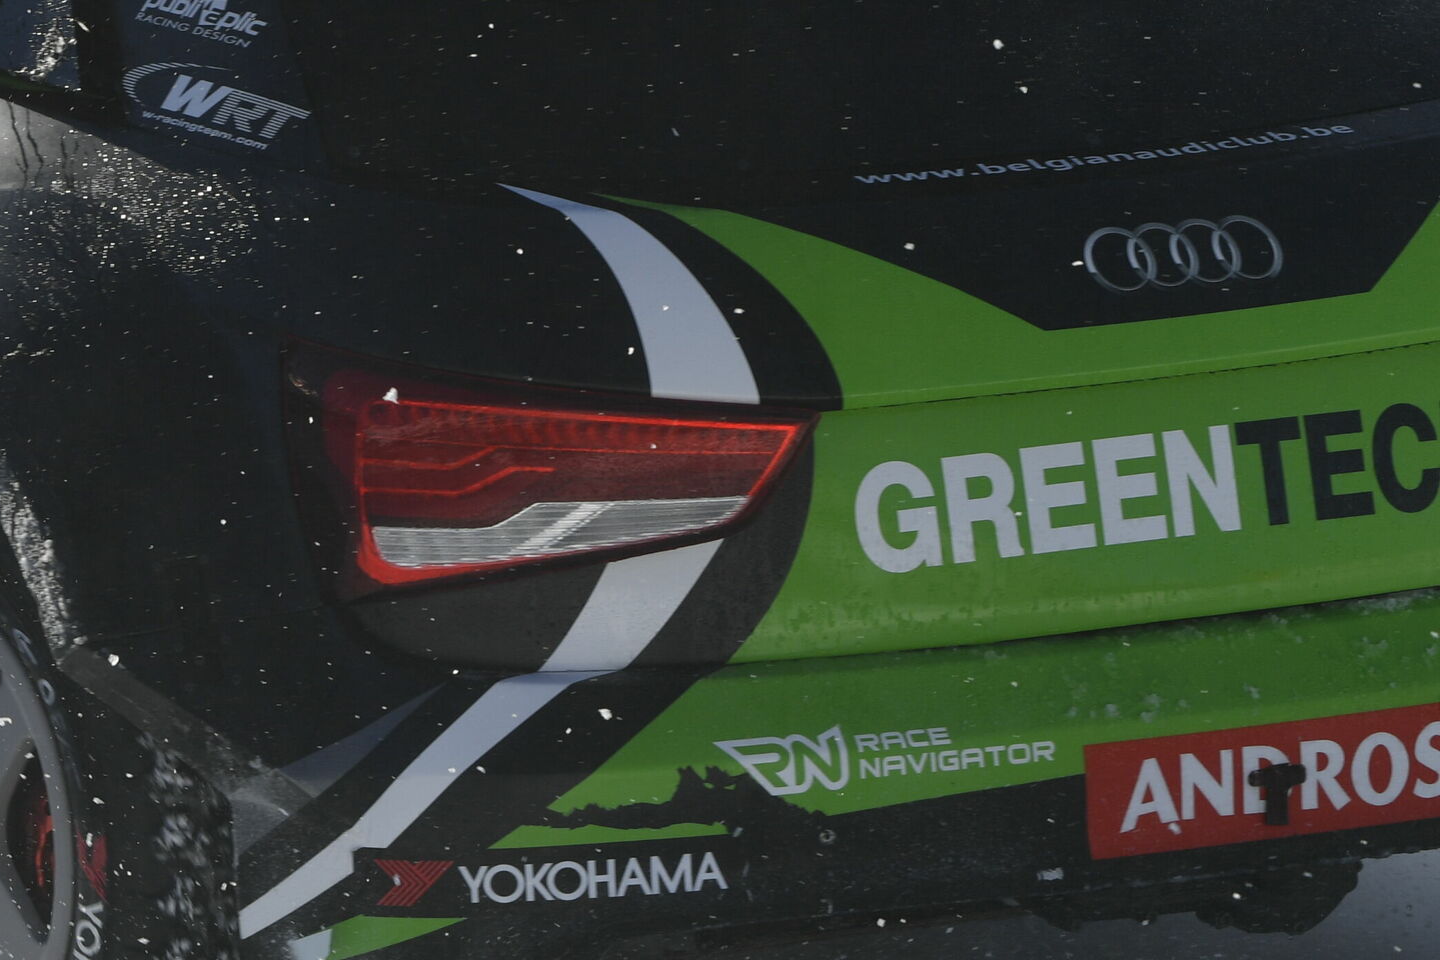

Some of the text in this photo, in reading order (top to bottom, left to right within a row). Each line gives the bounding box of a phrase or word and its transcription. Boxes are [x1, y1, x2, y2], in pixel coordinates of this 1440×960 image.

[134, 12, 252, 48] RACING DESIGN
[142, 110, 269, 151] w-racingteam.com
[160, 74, 312, 139] WRT
[854, 121, 1354, 185] www.belgianaudiclub.be
[854, 402, 1440, 574] GREENTEC
[854, 727, 952, 753] RACE
[859, 741, 1056, 780] NAVIGATOR
[1120, 721, 1440, 833] ANDROS
[457, 852, 729, 903] YOKOHAMA
